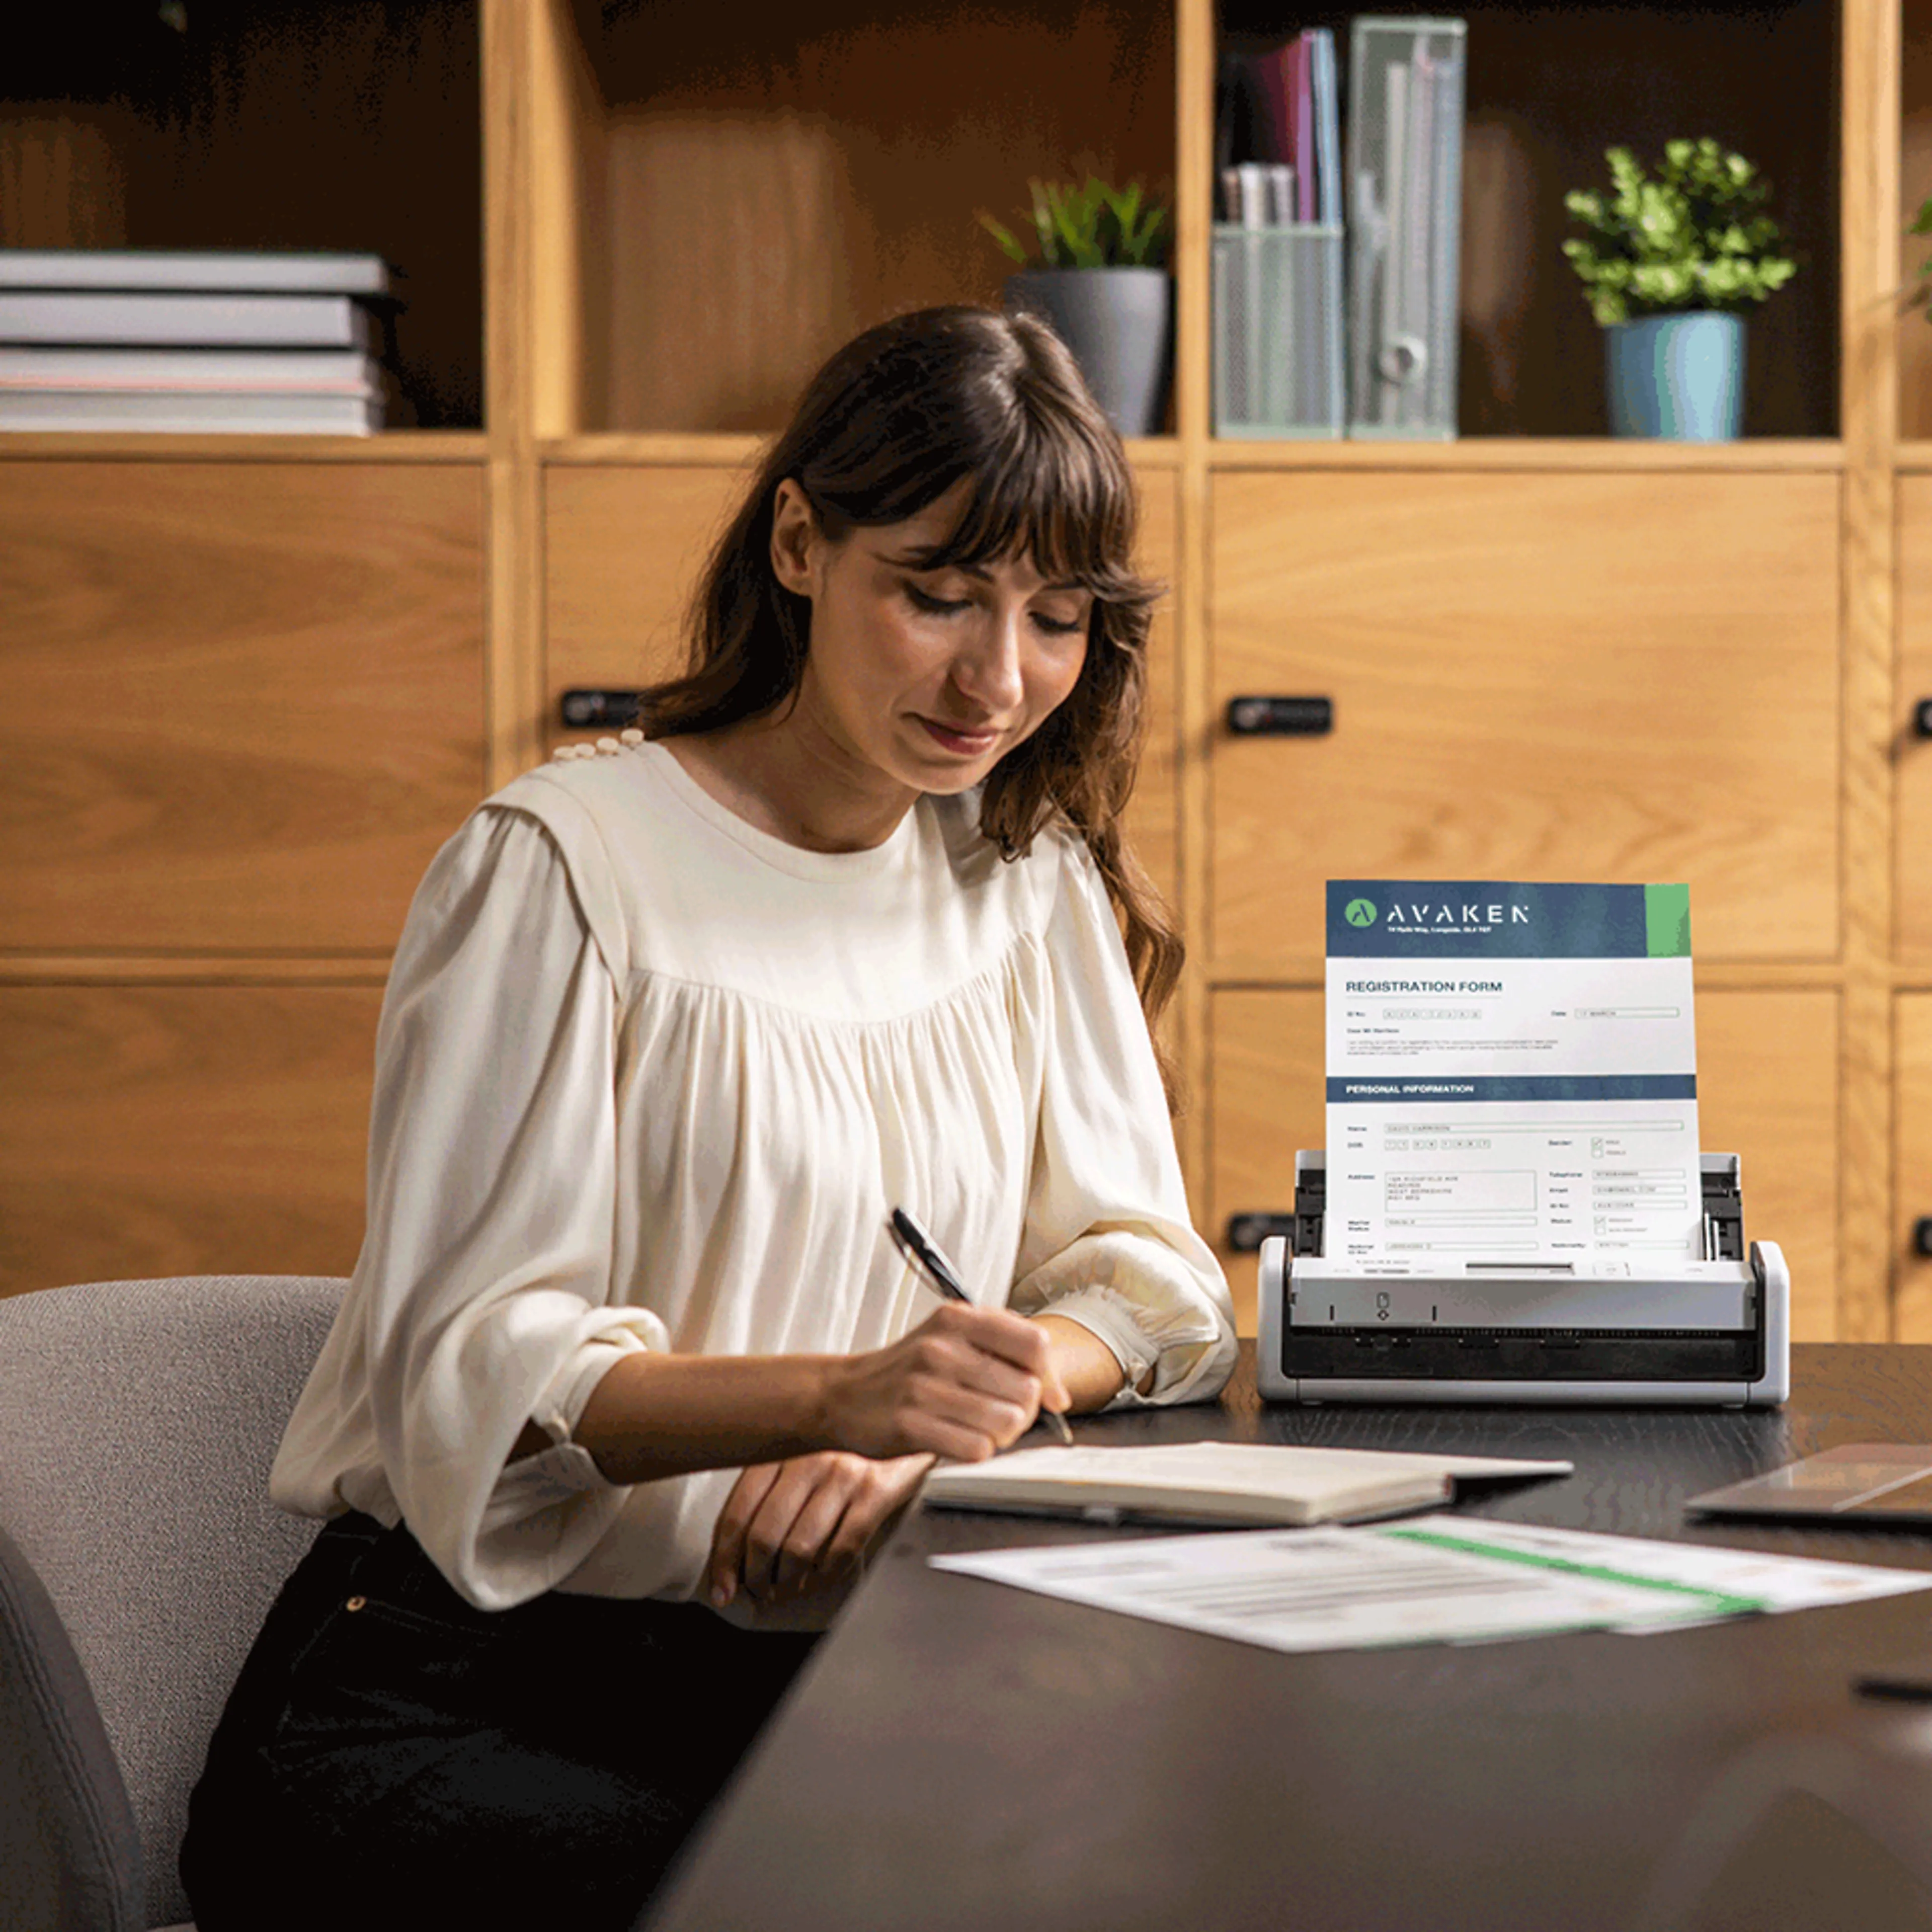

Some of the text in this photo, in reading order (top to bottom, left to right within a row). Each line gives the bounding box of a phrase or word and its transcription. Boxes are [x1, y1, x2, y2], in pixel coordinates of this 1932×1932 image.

[1387, 904, 1529, 923] AVAKEN
[1346, 981, 1502, 993] REGISTRATION FORM
[1346, 1084, 1474, 1094] PERSONAL INFORMATION
